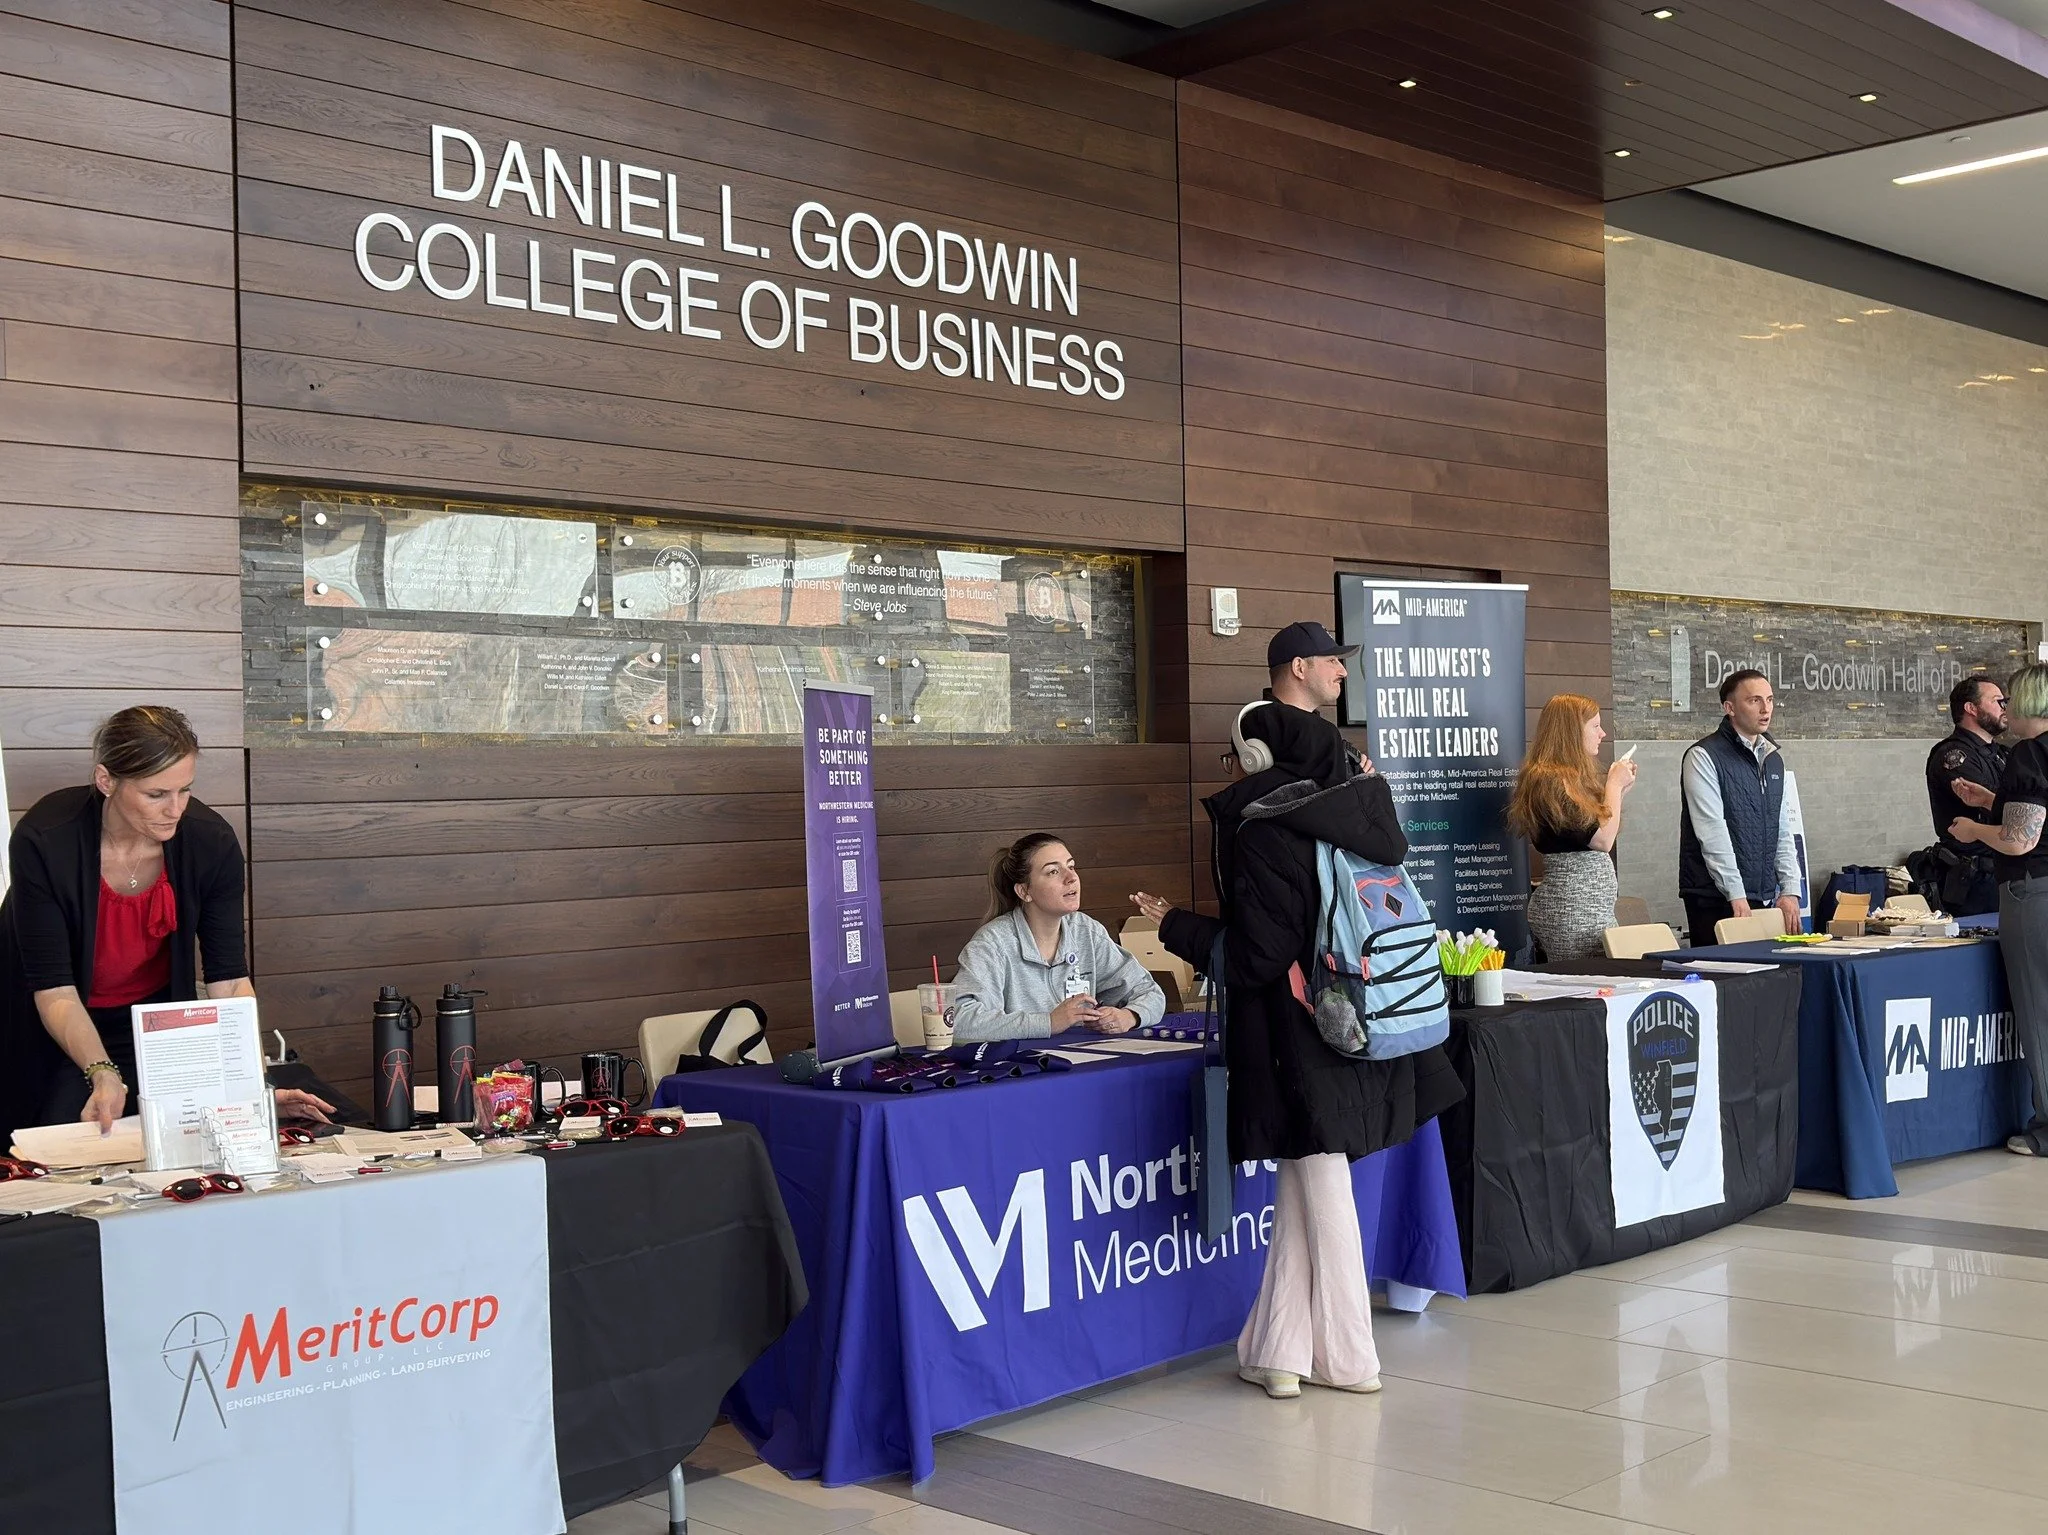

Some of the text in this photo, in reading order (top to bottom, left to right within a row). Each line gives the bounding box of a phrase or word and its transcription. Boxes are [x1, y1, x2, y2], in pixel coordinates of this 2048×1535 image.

[432, 124, 1078, 316] DANIEL L. GOODWIN
[355, 212, 1125, 400] COLLEGE OF BUSINESS
[803, 558, 826, 571] here
[829, 560, 848, 574] has
[850, 562, 866, 574] the
[868, 565, 897, 577] sense
[899, 566, 918, 578] that
[920, 568, 940, 581] right
[942, 572, 962, 581] now
[963, 572, 971, 582] is
[972, 573, 990, 583] one
[738, 574, 748, 586] of
[752, 574, 781, 587] those
[783, 579, 832, 591] moments
[833, 580, 860, 592] when
[863, 584, 877, 593] we
[880, 584, 896, 594] are
[898, 582, 948, 600] influencing
[950, 586, 965, 598] the
[853, 598, 907, 613] Steve Jobs
[1374, 647, 1404, 678] THE
[1778, 652, 1796, 690] L.
[1802, 653, 1886, 692] Goodwin
[1892, 656, 1925, 694] Hall
[1930, 660, 1946, 694] of
[1376, 688, 1468, 718] RETAIL REAL
[818, 728, 866, 744] BE PART OF
[1378, 727, 1498, 758] ESTATE LEADERS
[820, 749, 868, 765] SOMETHING
[829, 770, 862, 786] BETTER
[1420, 770, 1426, 778] in
[1448, 768, 1487, 778] Mid-America
[1488, 768, 1502, 776] Real
[1406, 782, 1412, 790] is
[1413, 782, 1422, 790] the
[1424, 782, 1447, 792] leading
[1449, 781, 1463, 789] retail
[819, 801, 873, 810] NORTHWESTERN MEDICINE
[1392, 792, 1460, 804] oughout the Midwest.
[1408, 820, 1450, 832] Services
[1408, 844, 1449, 853] Representation
[1454, 842, 1500, 852] Property Leasing
[1420, 859, 1435, 867] Sales
[1454, 855, 1508, 864] Asset Management
[1418, 872, 1434, 880] Sales
[1455, 869, 1478, 878] Facilities
[1456, 882, 1502, 892] Building Services
[1456, 893, 1528, 904] Construction Management
[1463, 905, 1499, 914] Development
[184, 1008, 216, 1018] MeritCorp
[834, 1002, 851, 1012] BETTER
[1633, 1000, 1694, 1047] POLICE
[1641, 1037, 1688, 1058] WINFIELD
[1940, 1011, 2025, 1071] MID-AMERI
[226, 1293, 500, 1389] MeritCorp
[226, 1349, 491, 1412] ENGINEERING PLANNING LAND SURVEYING
